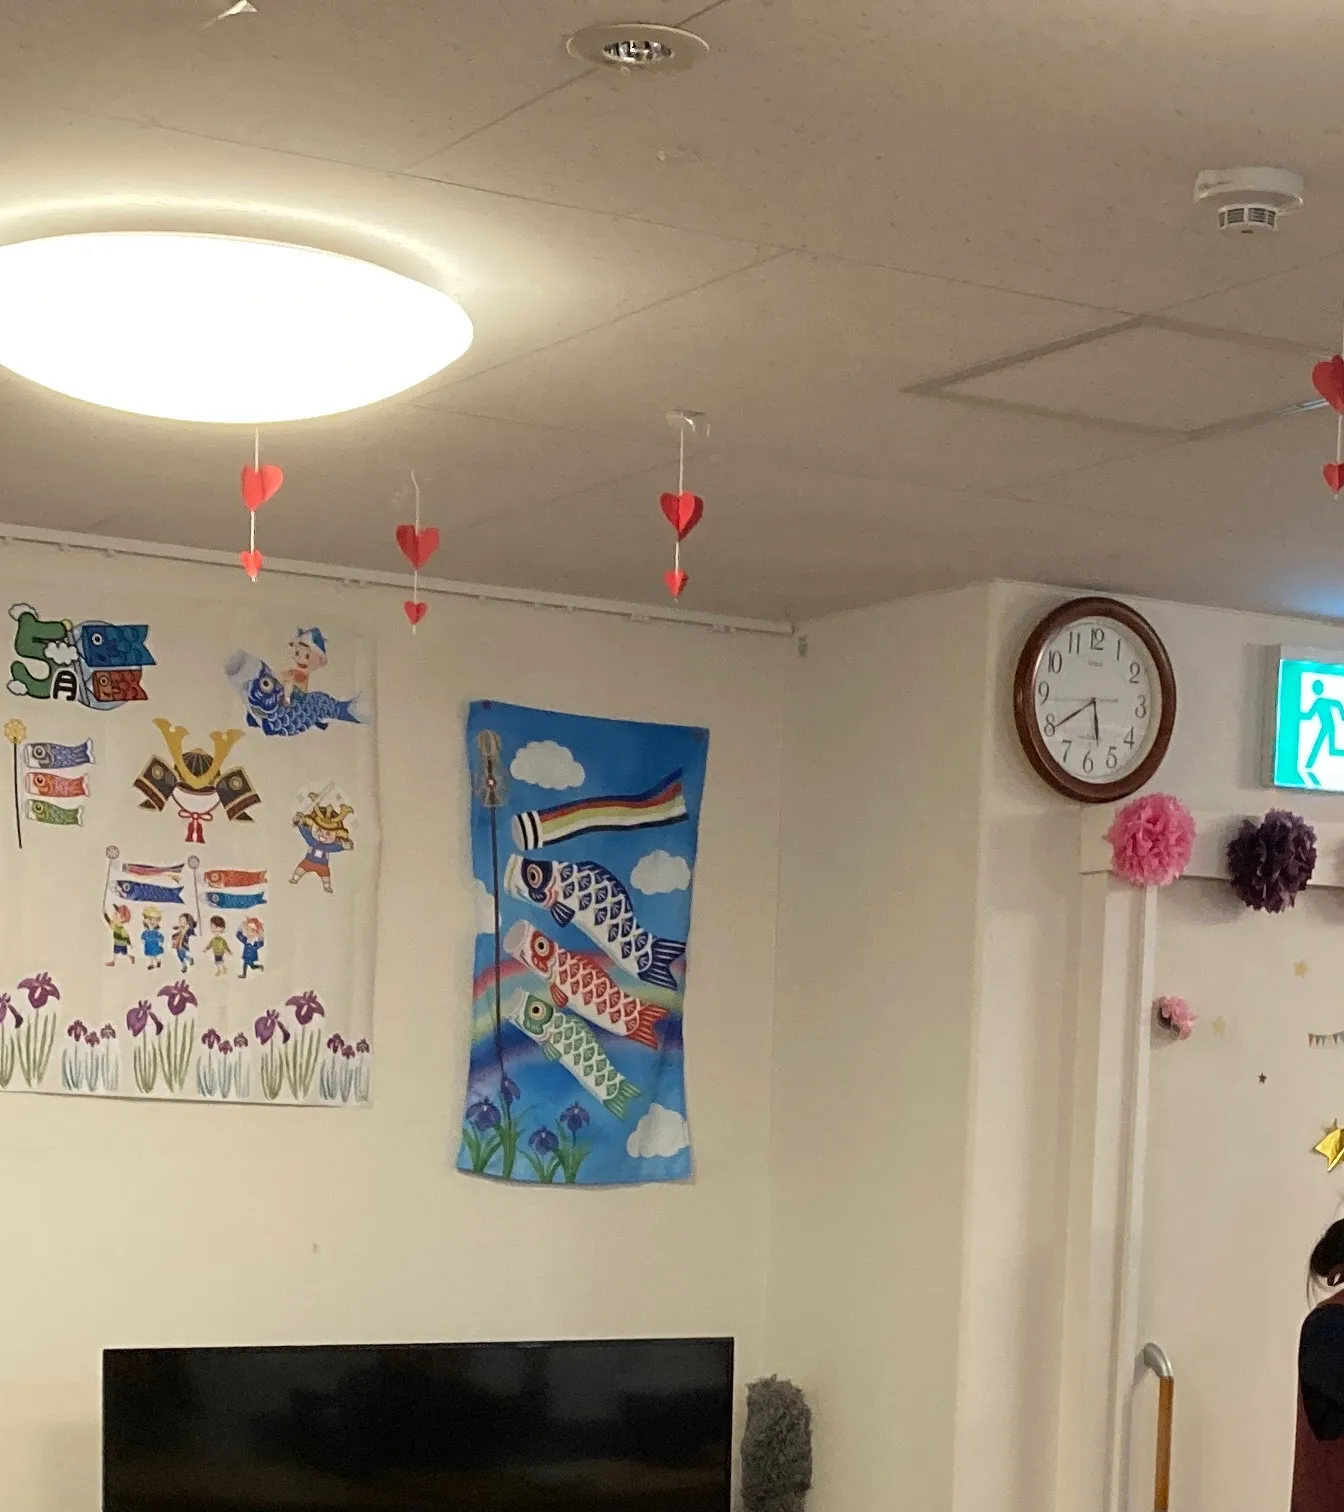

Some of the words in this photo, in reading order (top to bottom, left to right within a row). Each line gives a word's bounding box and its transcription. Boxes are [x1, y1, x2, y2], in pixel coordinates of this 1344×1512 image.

[1068, 631, 1080, 654] 11
[1090, 628, 1104, 650] 12
[1116, 638, 1121, 661] 1
[1047, 650, 1062, 674] 10
[1129, 662, 1140, 684] 2
[1038, 681, 1050, 705] 9
[1135, 695, 1146, 719] 3
[1043, 713, 1055, 737] 8
[1123, 726, 1135, 749] 4
[1061, 739, 1073, 763] 7
[1082, 750, 1093, 773] 6
[1106, 746, 1117, 769] 5
